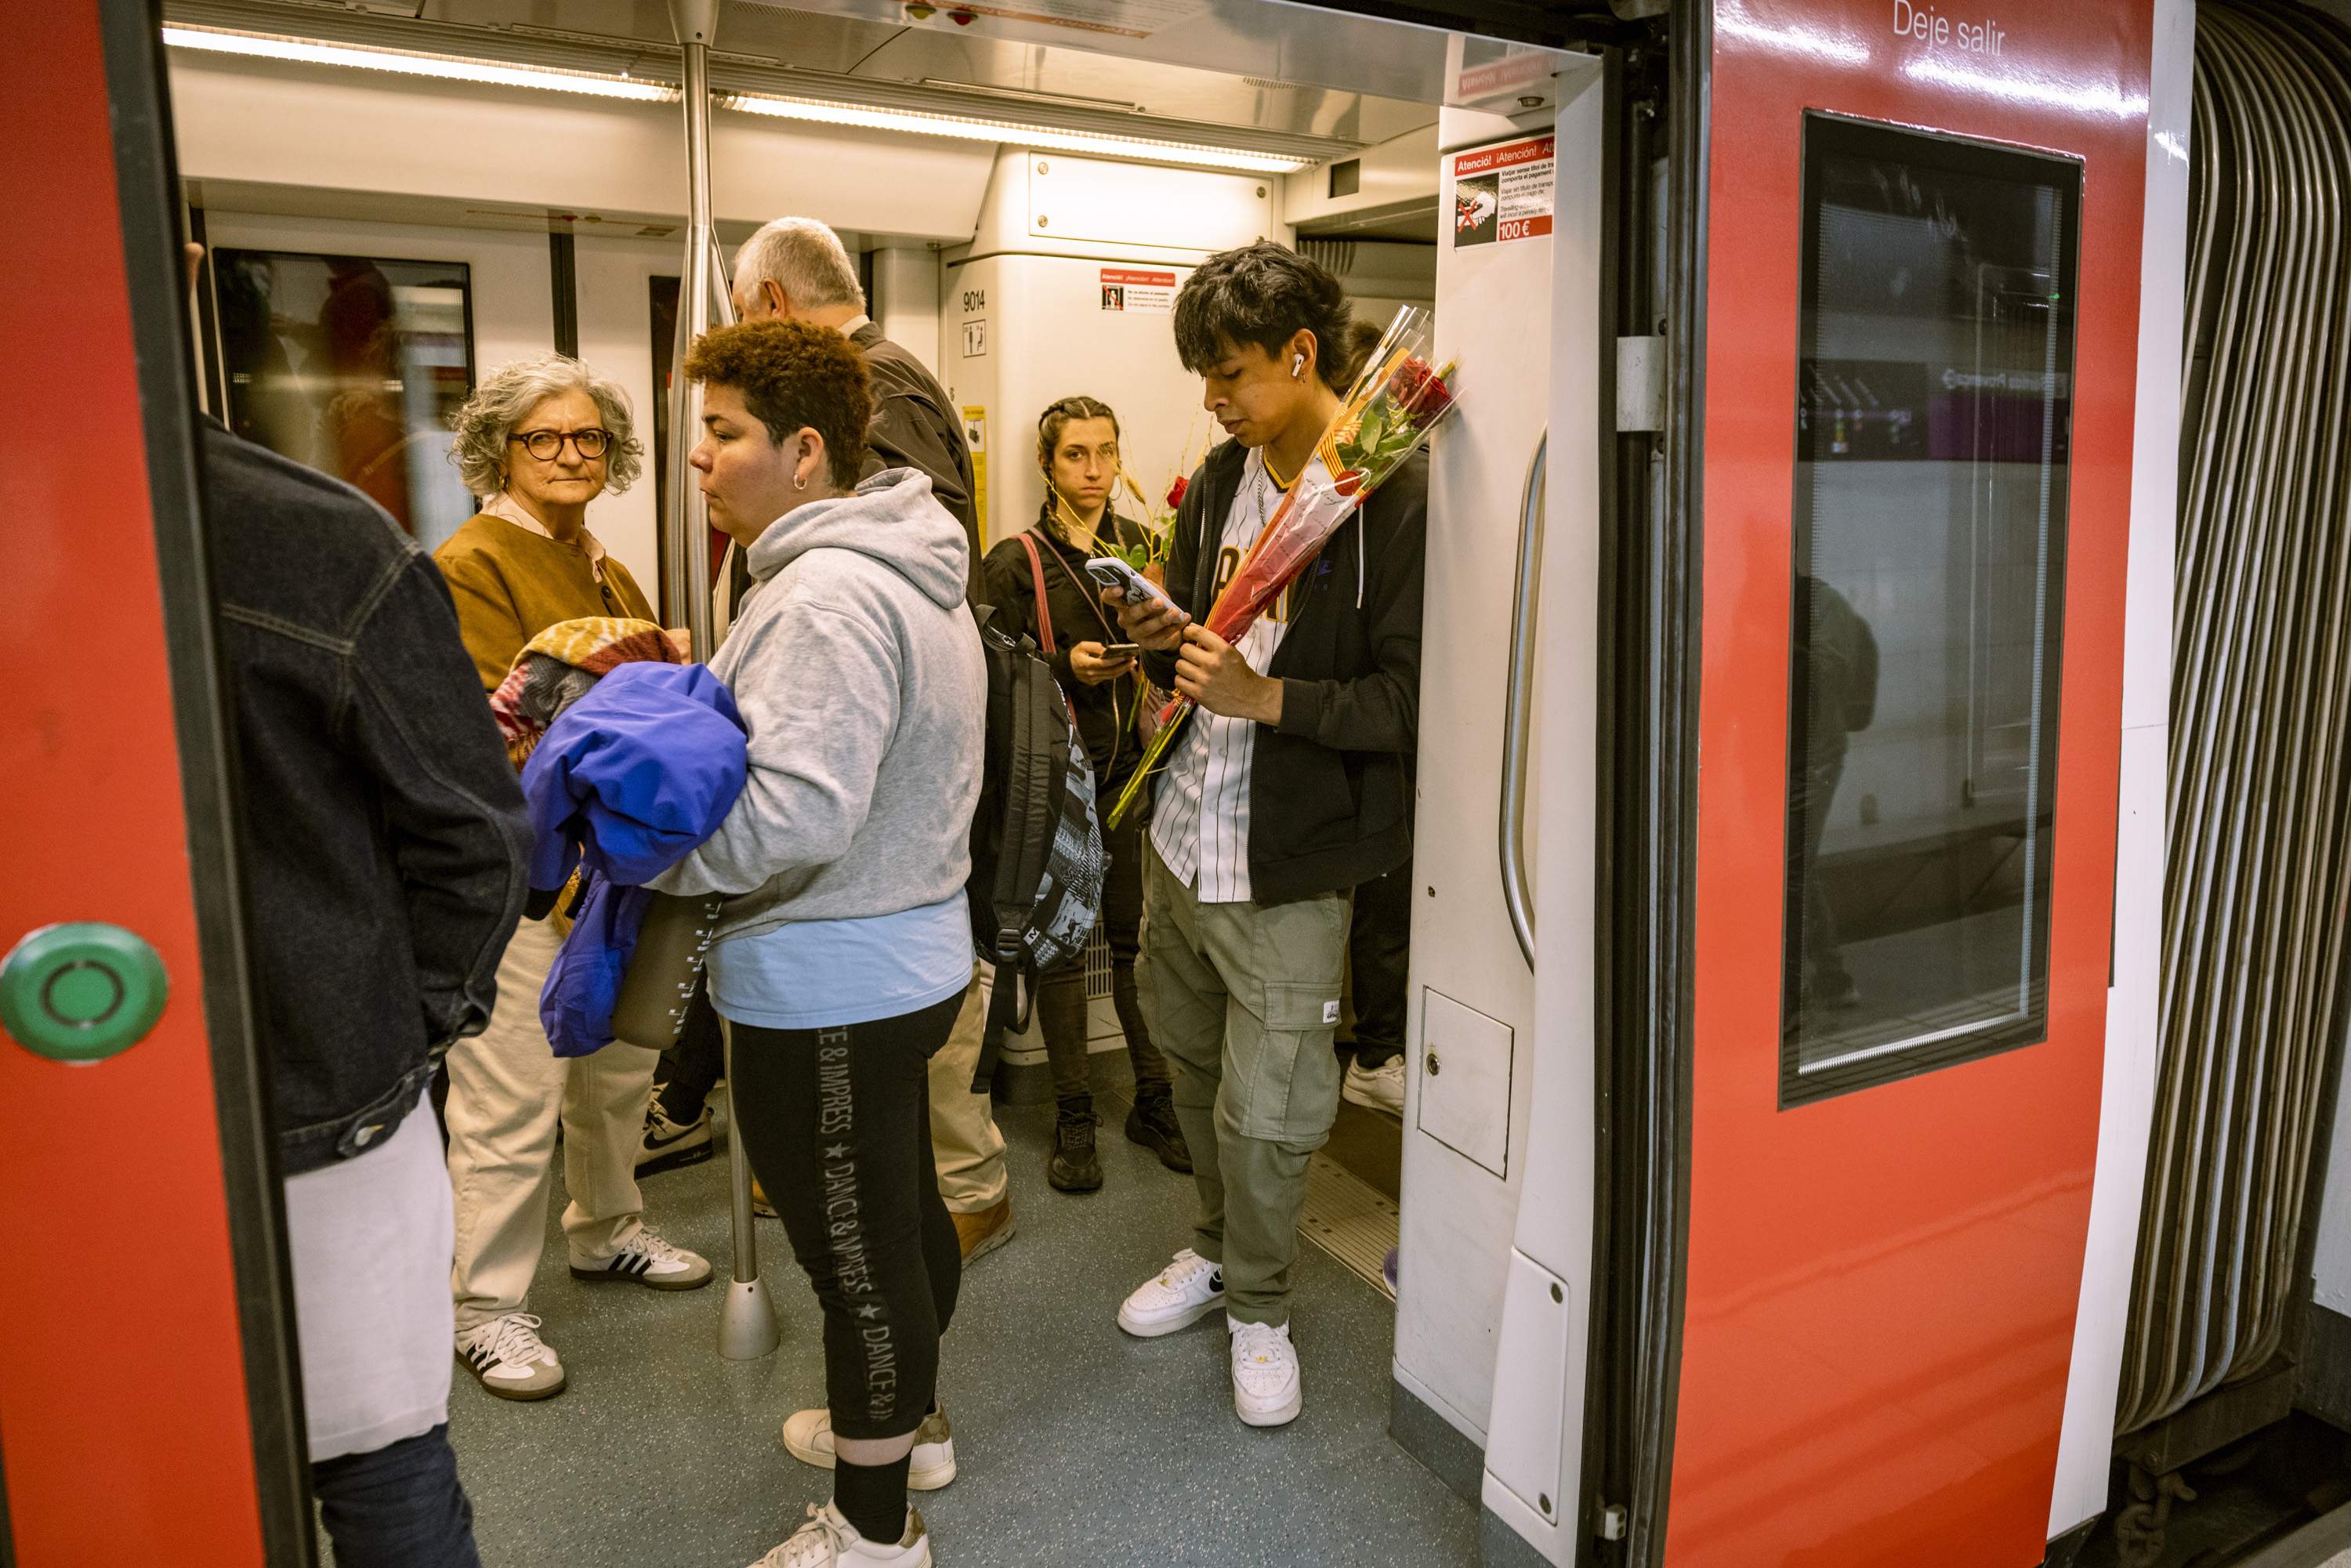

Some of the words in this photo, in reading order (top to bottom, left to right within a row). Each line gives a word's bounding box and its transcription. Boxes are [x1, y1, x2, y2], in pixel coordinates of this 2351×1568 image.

[1893, 0, 1950, 50] Deje
[1958, 20, 2005, 56] salir
[1458, 155, 1491, 172] Atenció!
[1496, 145, 1537, 164] ¡Atención!
[1500, 221, 1520, 239] 100
[1522, 220, 1530, 236] €
[963, 289, 985, 312] 9014
[820, 1047, 848, 1062] &
[820, 1063, 853, 1135] IMPRESS
[824, 1162, 859, 1222] DANCE
[830, 1220, 858, 1237] &
[863, 1325, 897, 1392] DANCE
[868, 1392, 896, 1407] &
